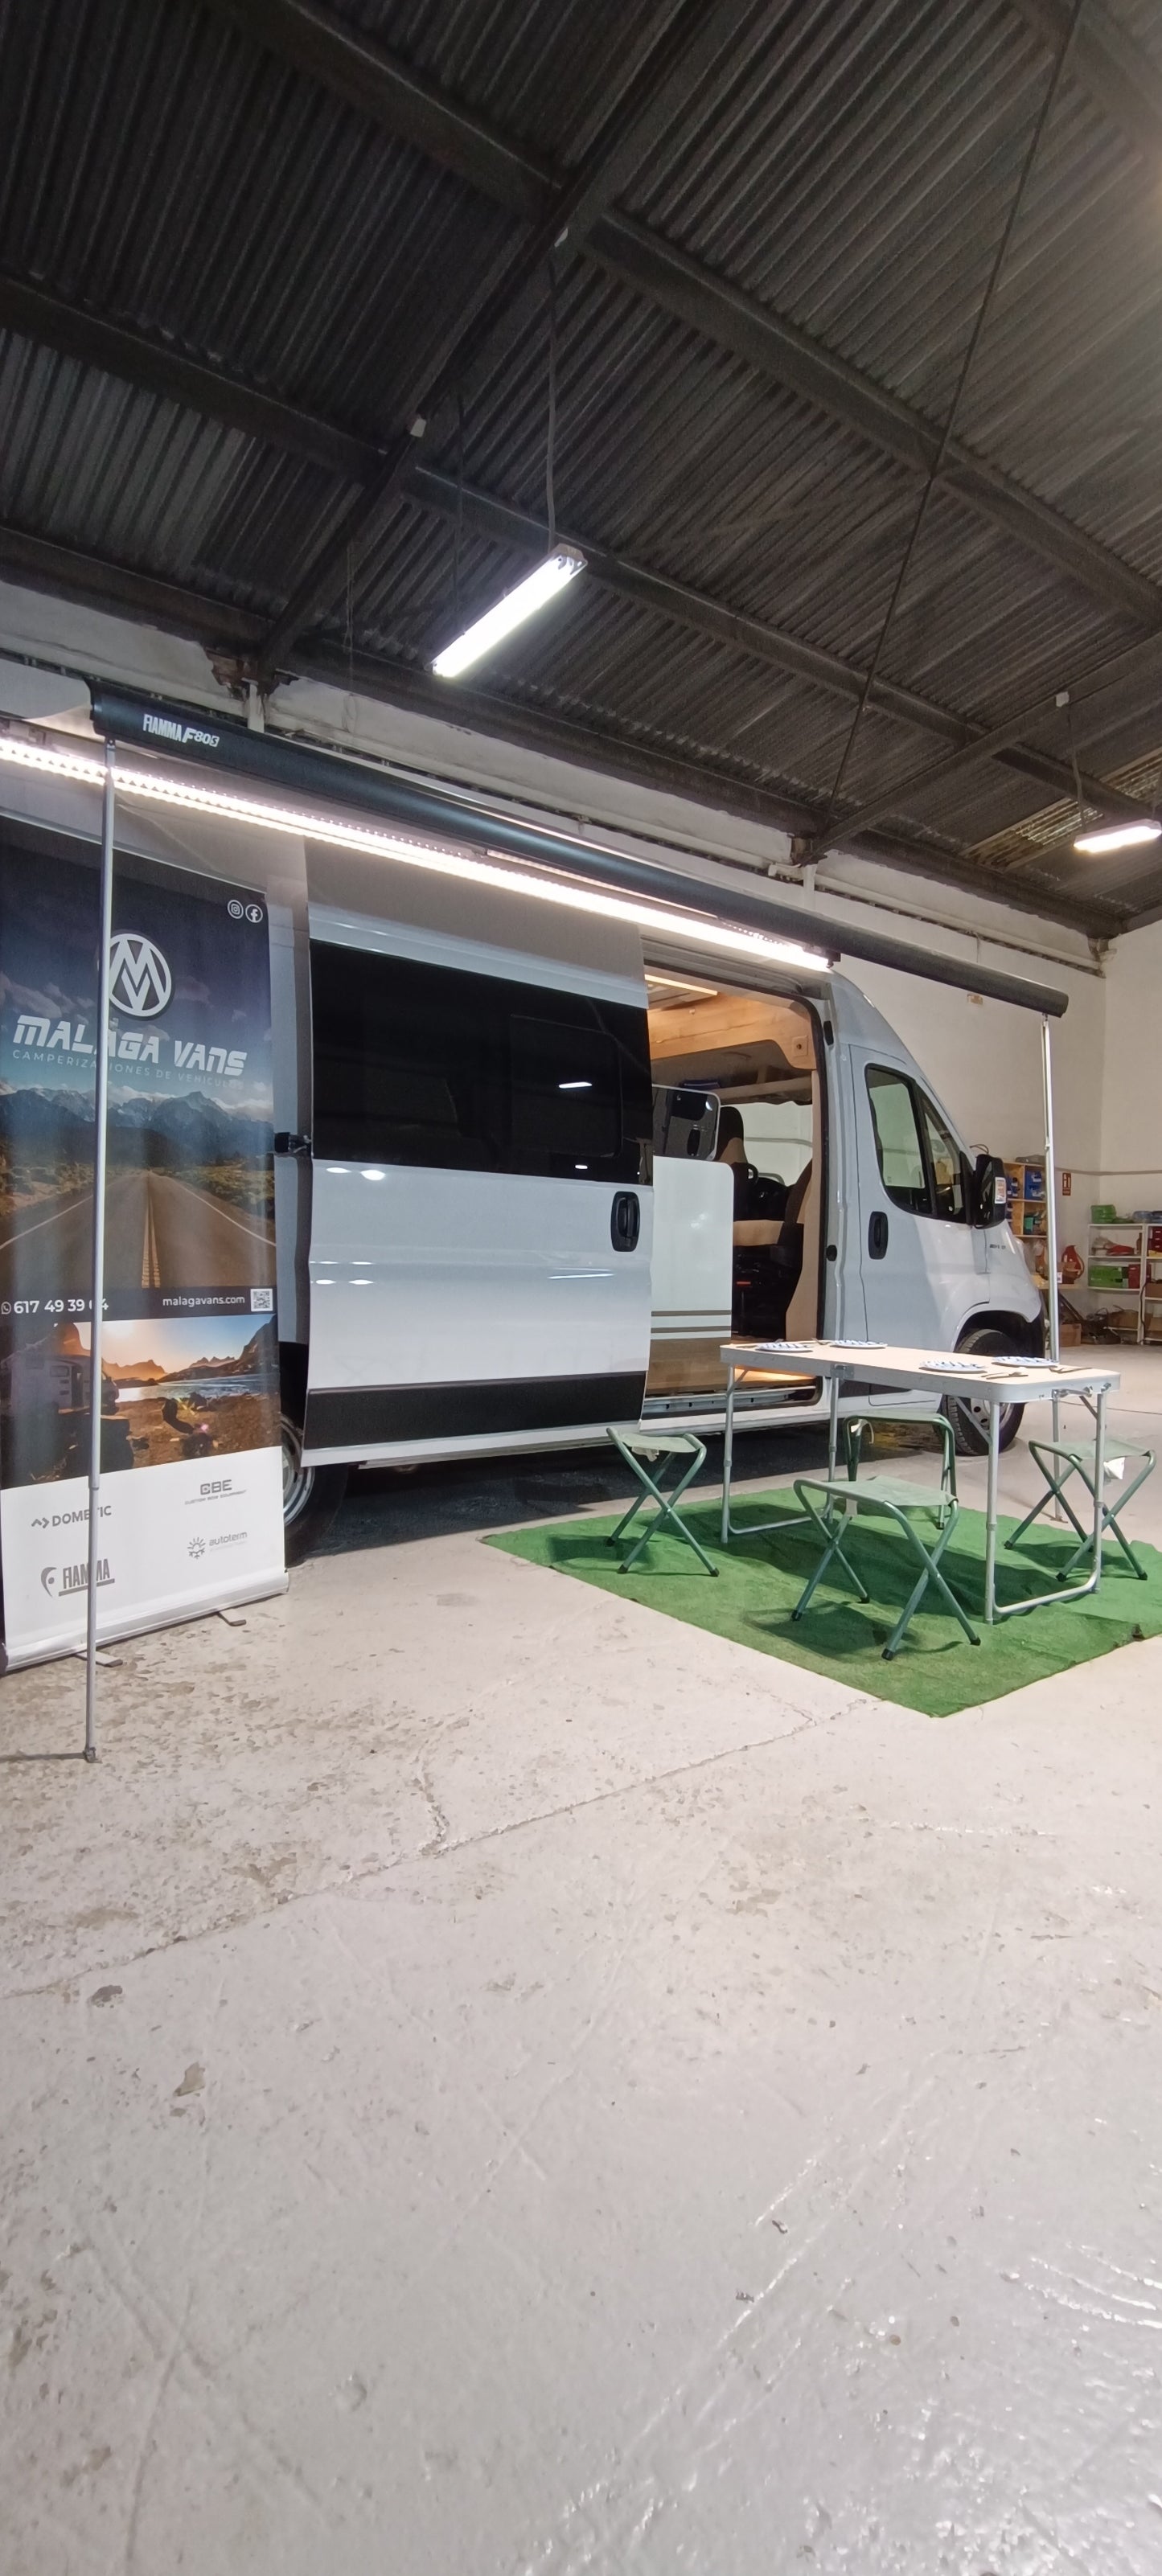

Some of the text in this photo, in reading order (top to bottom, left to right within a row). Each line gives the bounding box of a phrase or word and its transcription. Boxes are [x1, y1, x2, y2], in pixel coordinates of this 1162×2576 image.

[142, 713, 220, 748] FIAMMA F80S
[12, 1049, 150, 1076] CAMPERIZAIONES
[156, 1069, 171, 1080] DE
[174, 1040, 247, 1077] VANS
[14, 1300, 39, 1314] 617
[44, 1299, 64, 1312] 49
[68, 1298, 85, 1311] 39
[162, 1296, 245, 1307] malagavans.com
[52, 1505, 112, 1527] DOMEIC
[209, 1532, 248, 1546] autoterm
